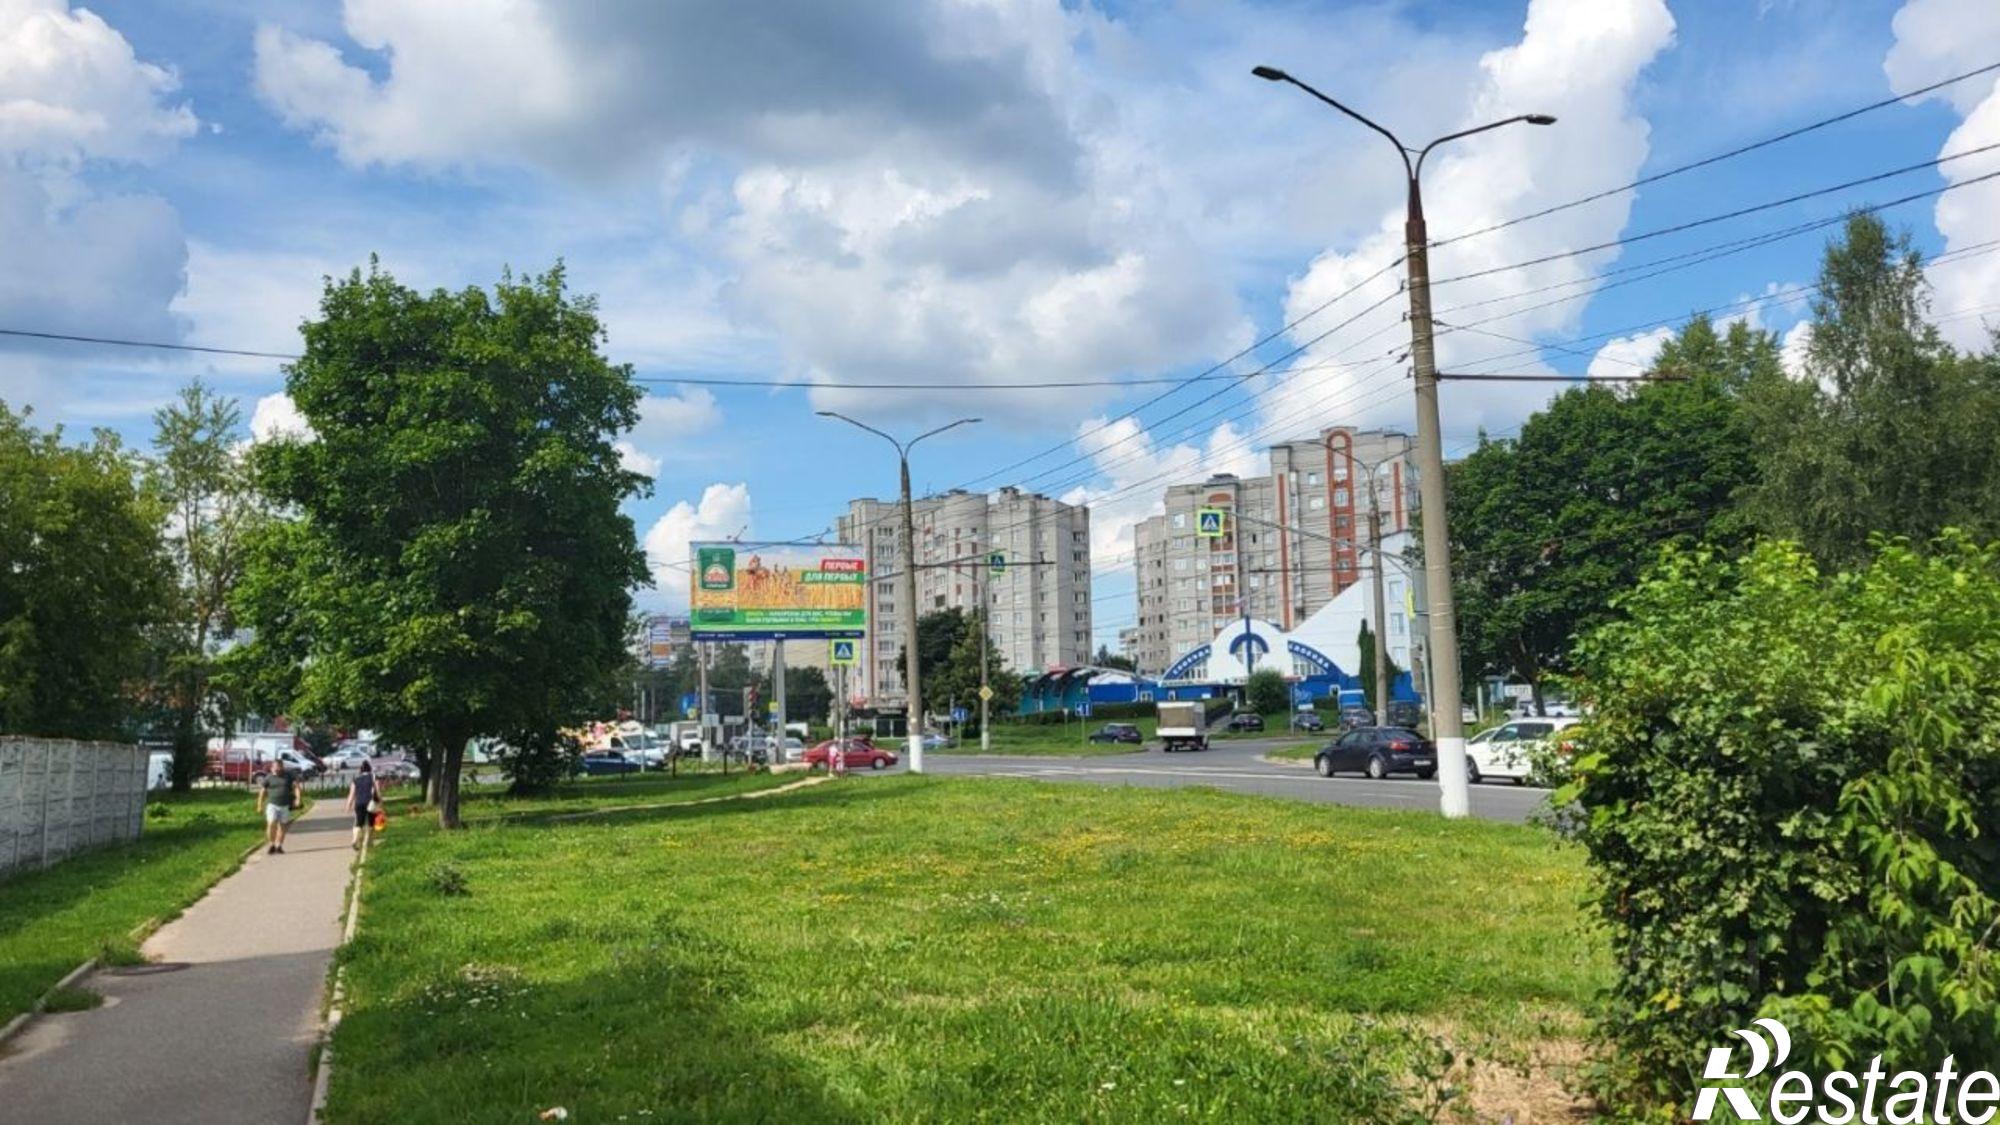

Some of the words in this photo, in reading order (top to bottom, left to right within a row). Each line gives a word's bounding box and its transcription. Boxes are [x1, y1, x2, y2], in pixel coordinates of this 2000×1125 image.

[824, 561, 858, 570] ПЕРВЫЕ
[805, 572, 822, 582] ДЛЯ
[824, 572, 858, 581] ПЕРВЫХ
